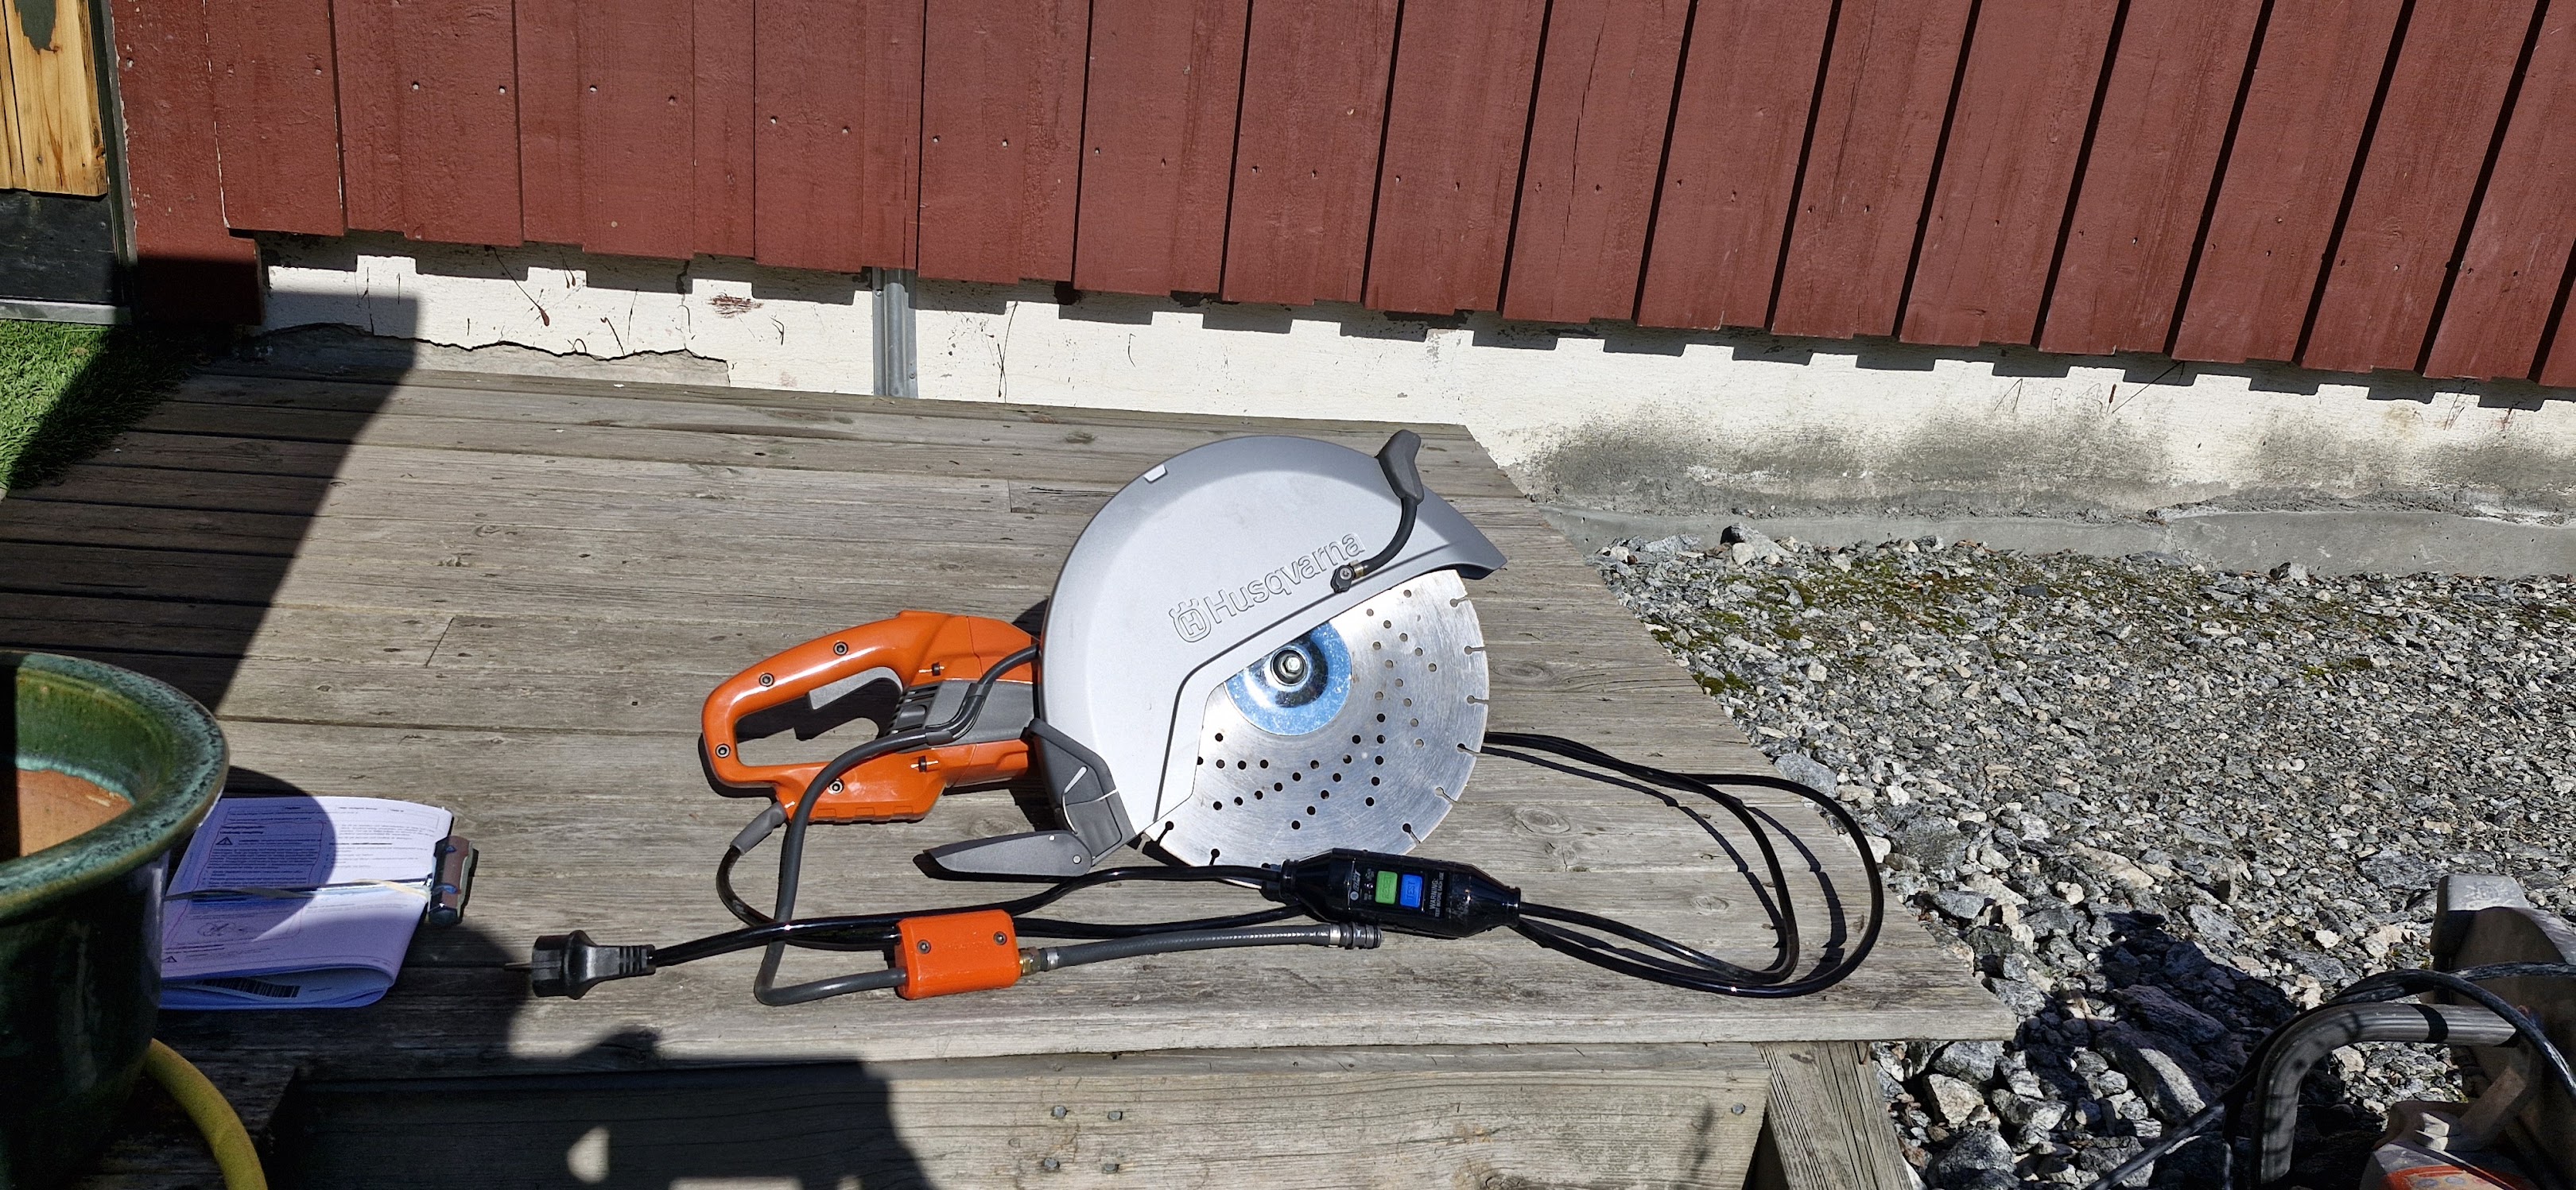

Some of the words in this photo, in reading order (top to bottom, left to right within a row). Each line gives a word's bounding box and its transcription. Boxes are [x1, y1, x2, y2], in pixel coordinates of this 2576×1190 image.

[1204, 533, 1365, 624] Husqvarna
[1406, 881, 1415, 900] TEST
[1429, 878, 1439, 909] WARNING:
